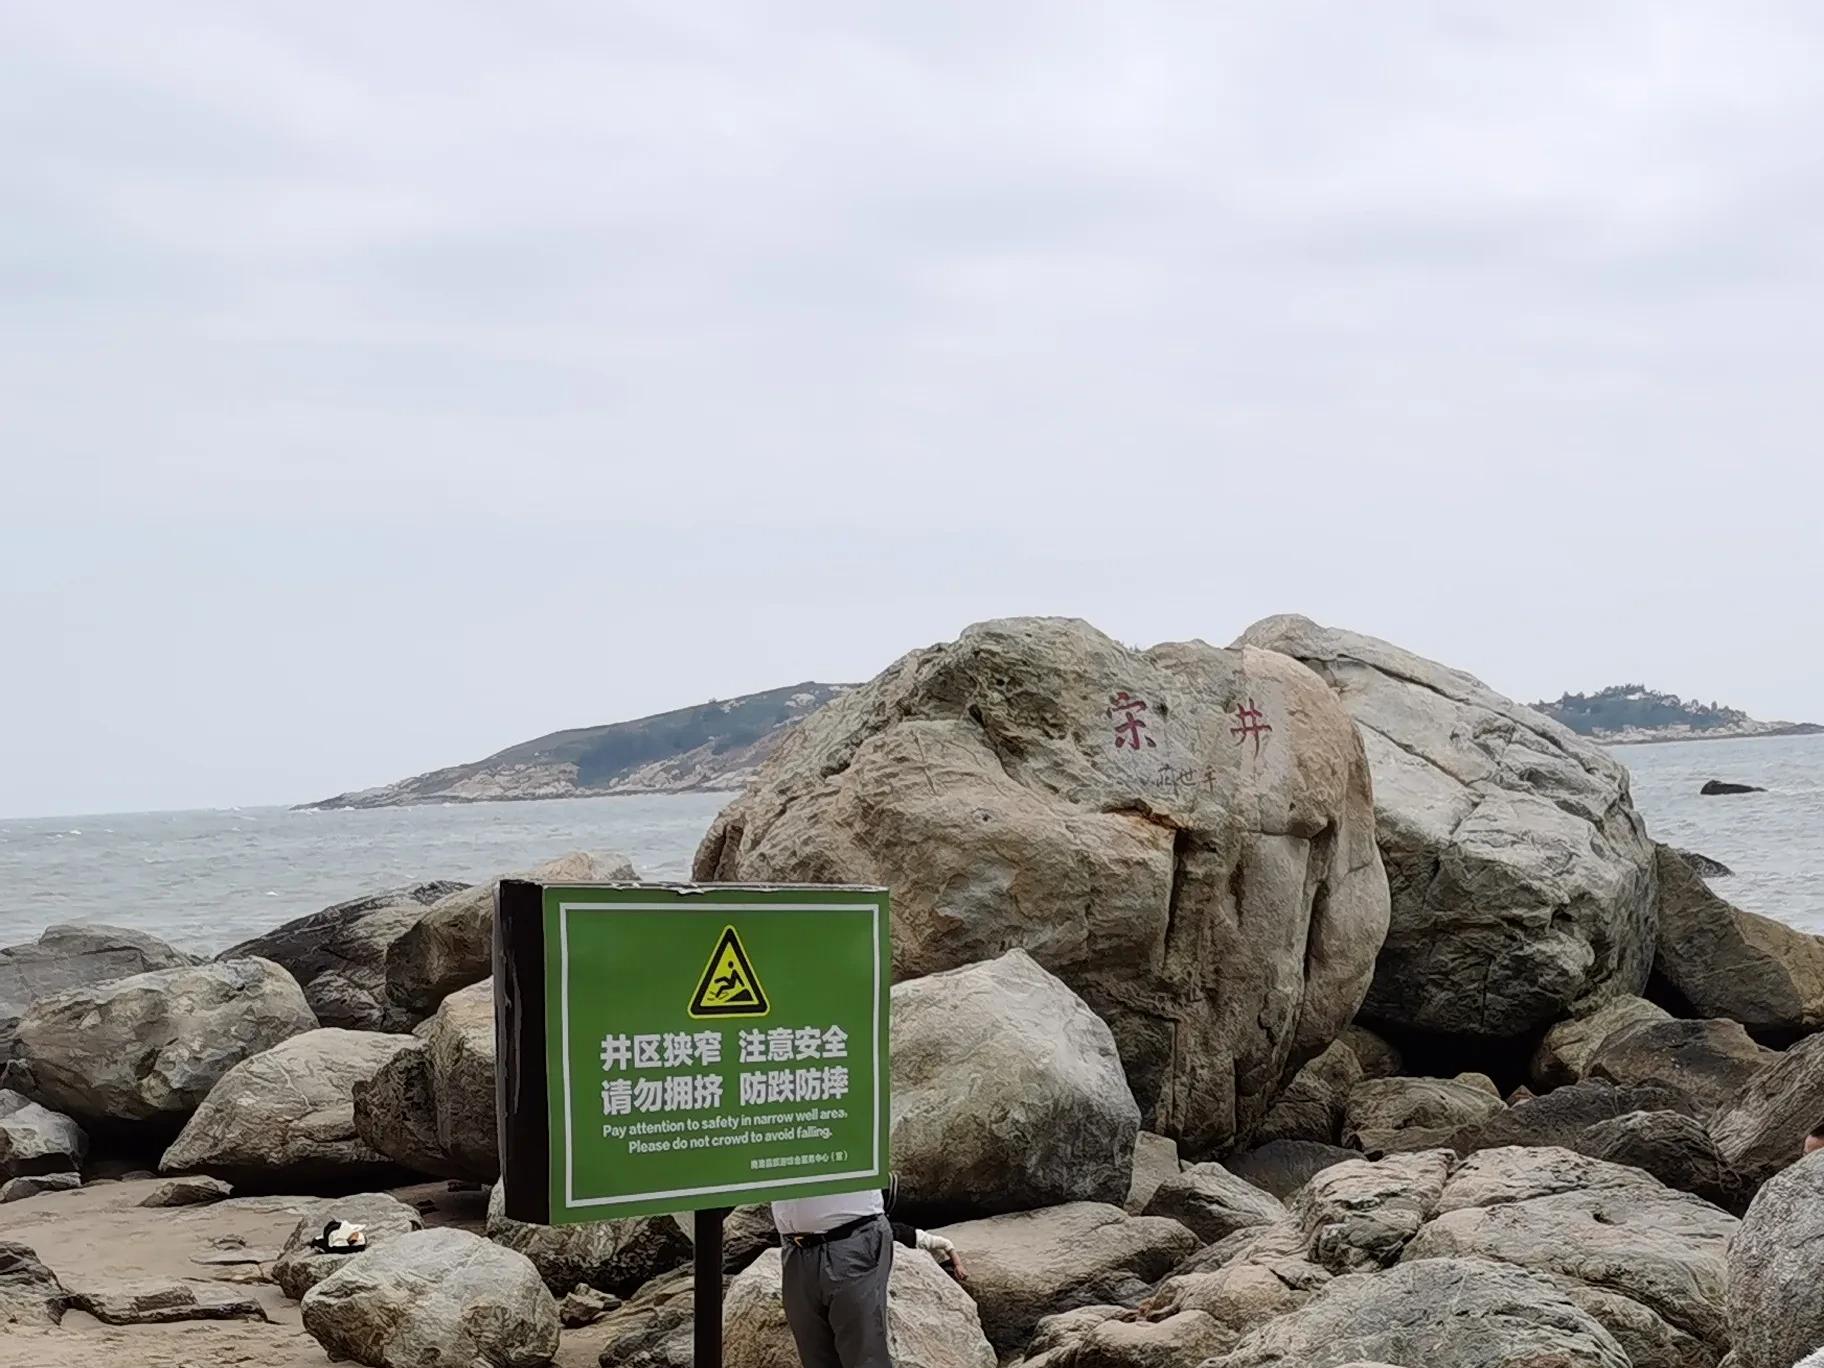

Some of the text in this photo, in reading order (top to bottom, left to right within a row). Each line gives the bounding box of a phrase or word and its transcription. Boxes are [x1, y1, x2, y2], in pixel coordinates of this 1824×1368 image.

[601, 1025, 849, 1071] 井区狭窄 注意安全
[601, 1066, 849, 1115] 请勿拥挤 防跌防摔
[602, 1124, 627, 1139] Pay
[629, 1120, 685, 1136] attention
[687, 1119, 700, 1130] to
[701, 1115, 740, 1130] safety
[741, 1114, 752, 1126] in
[753, 1113, 794, 1125] narrow
[795, 1108, 819, 1121] well
[629, 1140, 671, 1154] Please
[672, 1137, 688, 1150] do
[690, 1135, 710, 1149] not
[711, 1131, 750, 1147] crowd
[751, 1131, 763, 1142] to
[765, 1127, 795, 1141] avoid
